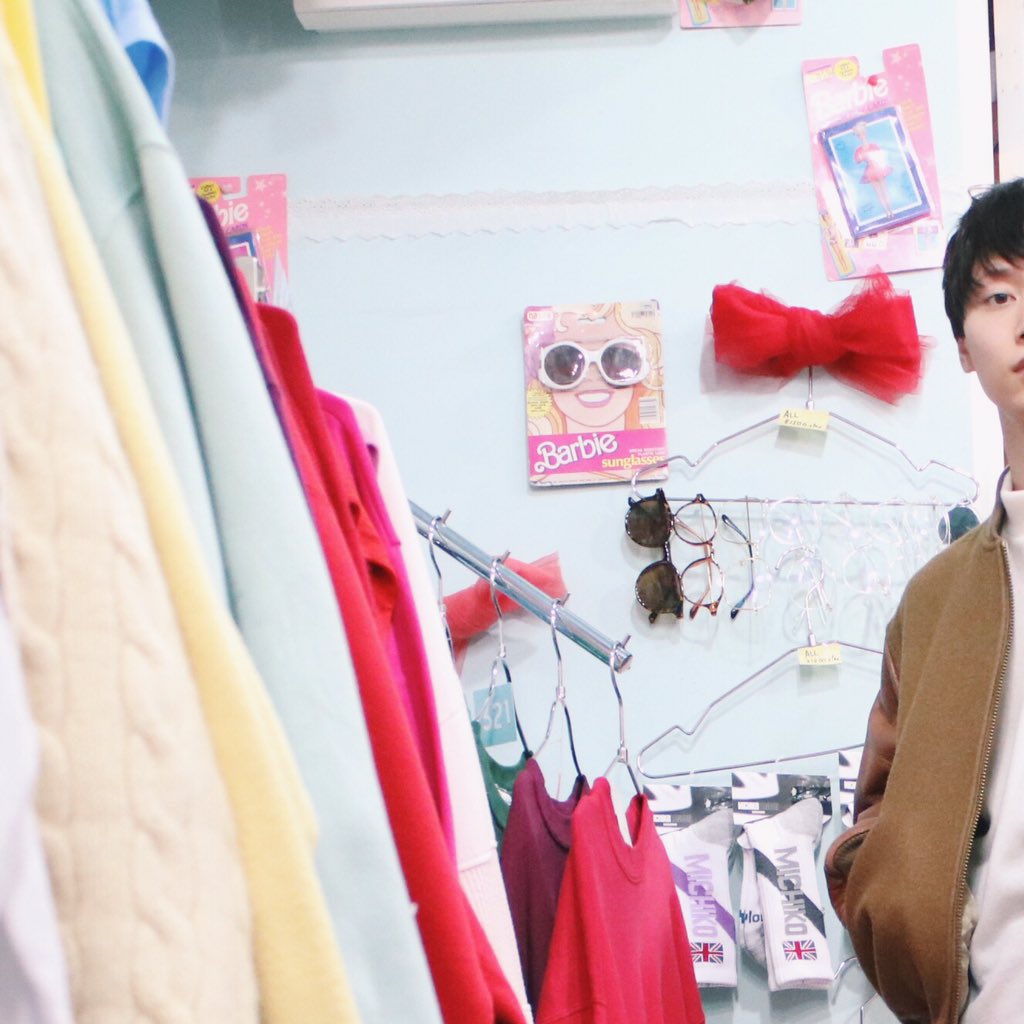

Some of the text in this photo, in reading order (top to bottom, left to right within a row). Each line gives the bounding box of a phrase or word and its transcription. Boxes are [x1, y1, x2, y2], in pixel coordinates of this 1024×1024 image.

[534, 432, 618, 473] Barbie
[683, 853, 718, 938] MICHIKO
[774, 846, 808, 936] MICHIKO
